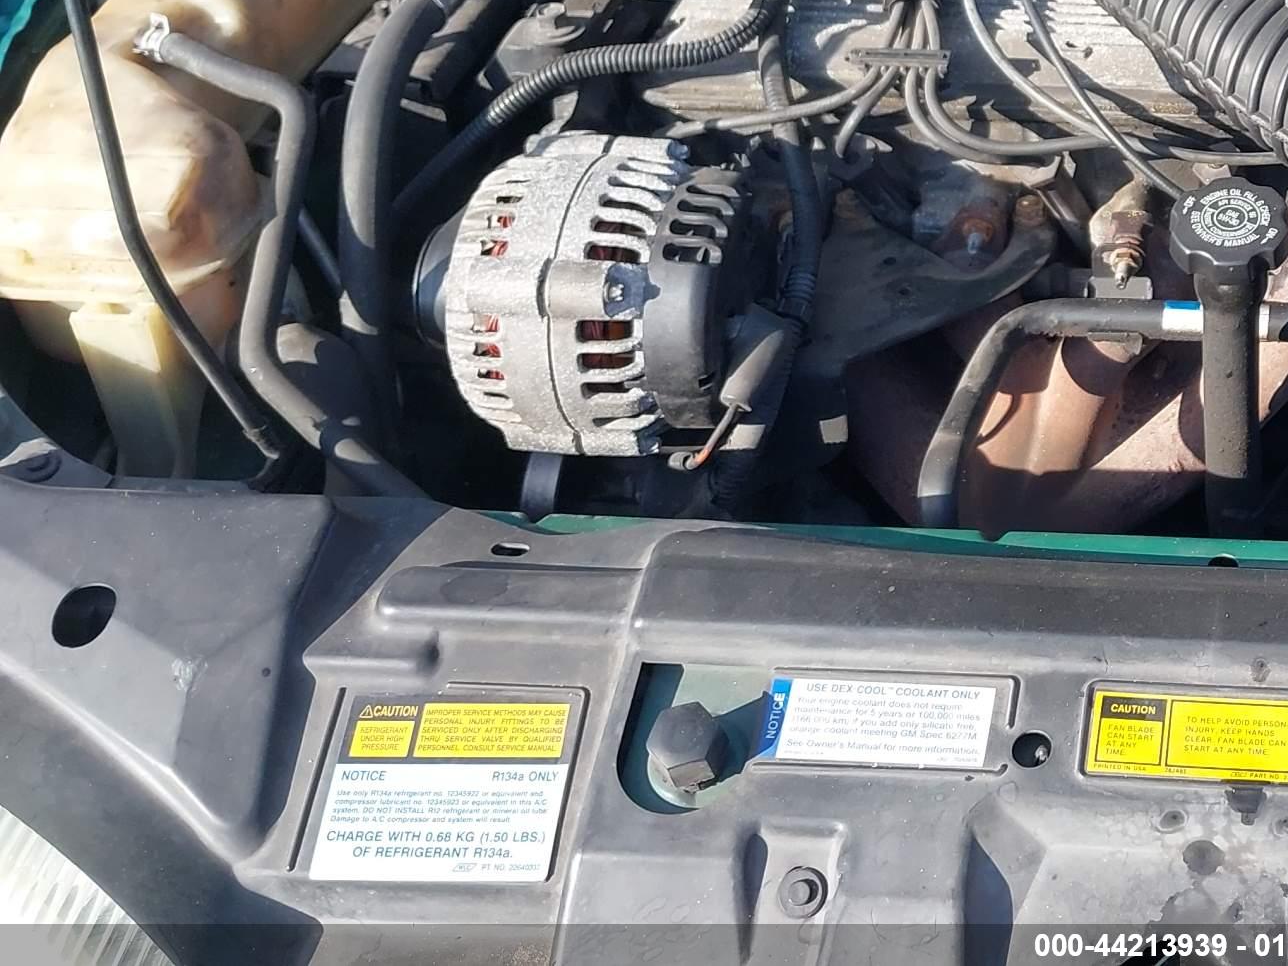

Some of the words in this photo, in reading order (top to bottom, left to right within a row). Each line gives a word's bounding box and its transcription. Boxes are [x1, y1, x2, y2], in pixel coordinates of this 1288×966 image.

[1229, 188, 1242, 196] OIL
[1243, 191, 1258, 202] FILL
[1260, 205, 1271, 227] CHECK
[1223, 233, 1261, 247] MANUAL
[806, 683, 828, 692] USE
[831, 684, 853, 693] DEX
[895, 687, 949, 698] COOLANT
[951, 690, 980, 699] ONLY
[819, 698, 849, 707] engine
[851, 698, 886, 707] coolant
[888, 700, 911, 708] does
[373, 705, 419, 717] CAUTION
[493, 709, 527, 717] METHODS
[528, 709, 543, 717] MAY
[543, 709, 567, 717] CAUSE
[855, 707, 868, 716] for
[879, 710, 903, 719] years
[1110, 703, 1156, 715] CAUTION
[765, 692, 786, 739] NOTICE
[1186, 715, 1198, 723] TO
[1200, 717, 1222, 725] HELP
[1224, 718, 1250, 726] AVOID
[879, 719, 898, 727] add
[900, 721, 919, 730] only
[1108, 724, 1125, 732] FAN
[1127, 725, 1155, 734] BLADE
[360, 726, 408, 734] REFRIGERANT
[422, 726, 459, 734] SERVICED
[462, 726, 482, 734] ONLY
[824, 727, 859, 735] coolant
[861, 728, 898, 739] meeting
[900, 730, 918, 739] GM
[919, 730, 944, 740] Spec
[1220, 727, 1242, 736] KEEP
[1245, 729, 1275, 737] HANDS
[360, 735, 385, 743] UNDER
[386, 735, 405, 743] HIGH
[420, 735, 441, 743] THRU
[444, 735, 478, 743] SERVICE
[481, 735, 504, 743] VALVE
[508, 735, 519, 743] BY
[523, 735, 562, 743] QUALIFIED
[1107, 732, 1125, 740] CAN
[1127, 733, 1154, 742] START
[1217, 736, 1235, 744] FAN
[1238, 738, 1265, 746] BLADE
[1268, 739, 1287, 747] CAN
[463, 744, 495, 752] CONSULT
[496, 744, 526, 752] SERVICE
[787, 738, 803, 747] See
[806, 739, 845, 749] Owner's
[847, 741, 881, 751] Manual
[884, 743, 896, 752] for
[898, 745, 923, 753] more
[1119, 740, 1137, 748] ANY
[1184, 745, 1210, 753] START
[1213, 745, 1224, 753] AT
[1227, 746, 1244, 754] ANY
[1093, 762, 1122, 770] PRINTED
[341, 770, 387, 781] NOTICE
[491, 771, 525, 782] R134a
[528, 771, 560, 782] ONLY
[353, 789, 369, 798] only
[394, 789, 432, 798] refrigerant
[491, 790, 529, 798] equivalent
[334, 798, 378, 806] compressor
[471, 799, 509, 807] equivalent
[519, 798, 532, 806] this
[442, 807, 482, 816] refrigerant
[492, 807, 519, 815] mineral
[330, 815, 360, 824] Damage
[387, 816, 430, 824] compressor
[447, 816, 474, 824] system
[326, 830, 384, 842] CHARGE
[388, 831, 422, 842] WITH
[425, 831, 452, 842] 0.68
[455, 831, 475, 842] KG
[479, 831, 509, 844] (1.50
[513, 831, 546, 844] LBS.)
[352, 846, 372, 858] OF
[375, 846, 470, 858] REFRIGERANT
[473, 847, 513, 858] R134a.
